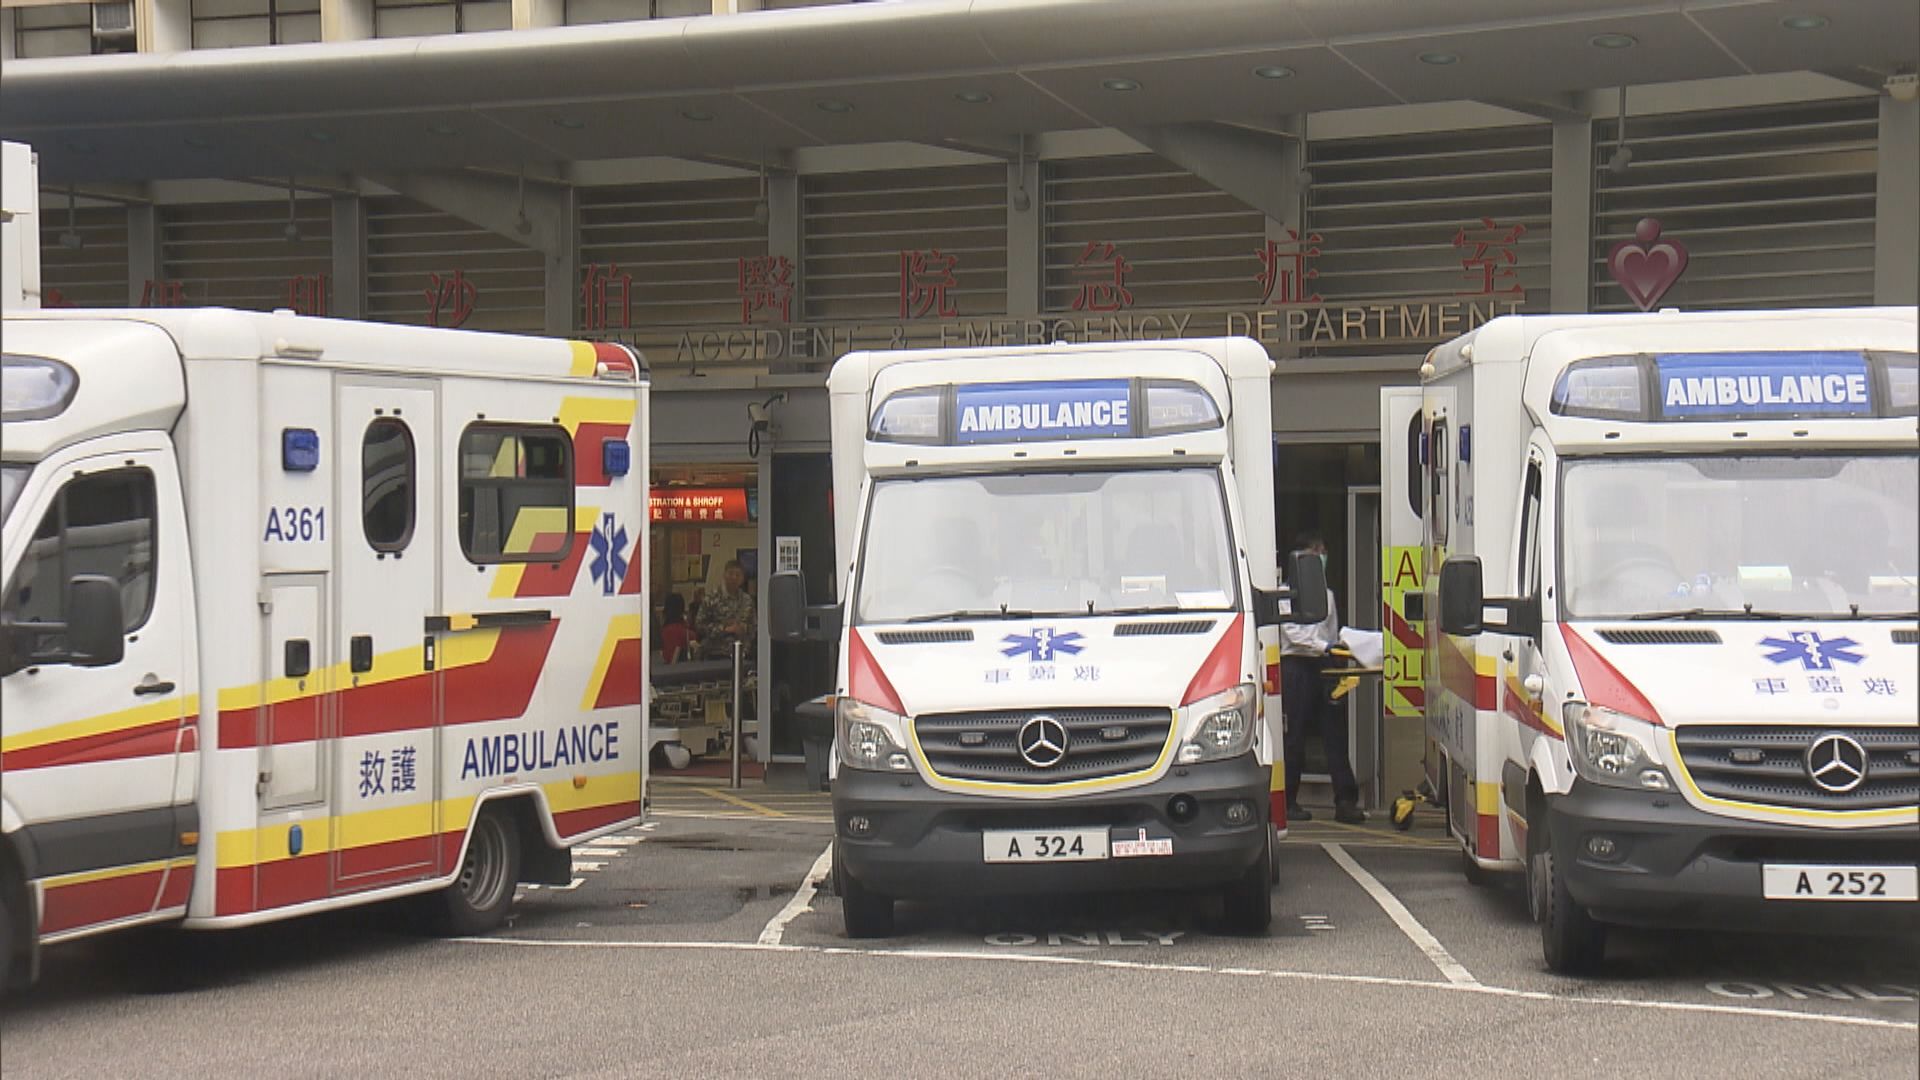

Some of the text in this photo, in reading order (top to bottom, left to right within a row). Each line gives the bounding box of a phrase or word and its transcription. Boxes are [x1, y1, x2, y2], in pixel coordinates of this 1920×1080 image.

[942, 312, 1192, 349] EMERGENCY
[1666, 373, 1867, 406] AMBULANCE
[960, 400, 1128, 432] AMBULANCE
[264, 507, 325, 542] A361
[461, 722, 619, 780] AMBULANCE
[359, 747, 416, 798] 救護
[1008, 835, 1084, 858] A 324
[1796, 872, 1887, 896] A 252
